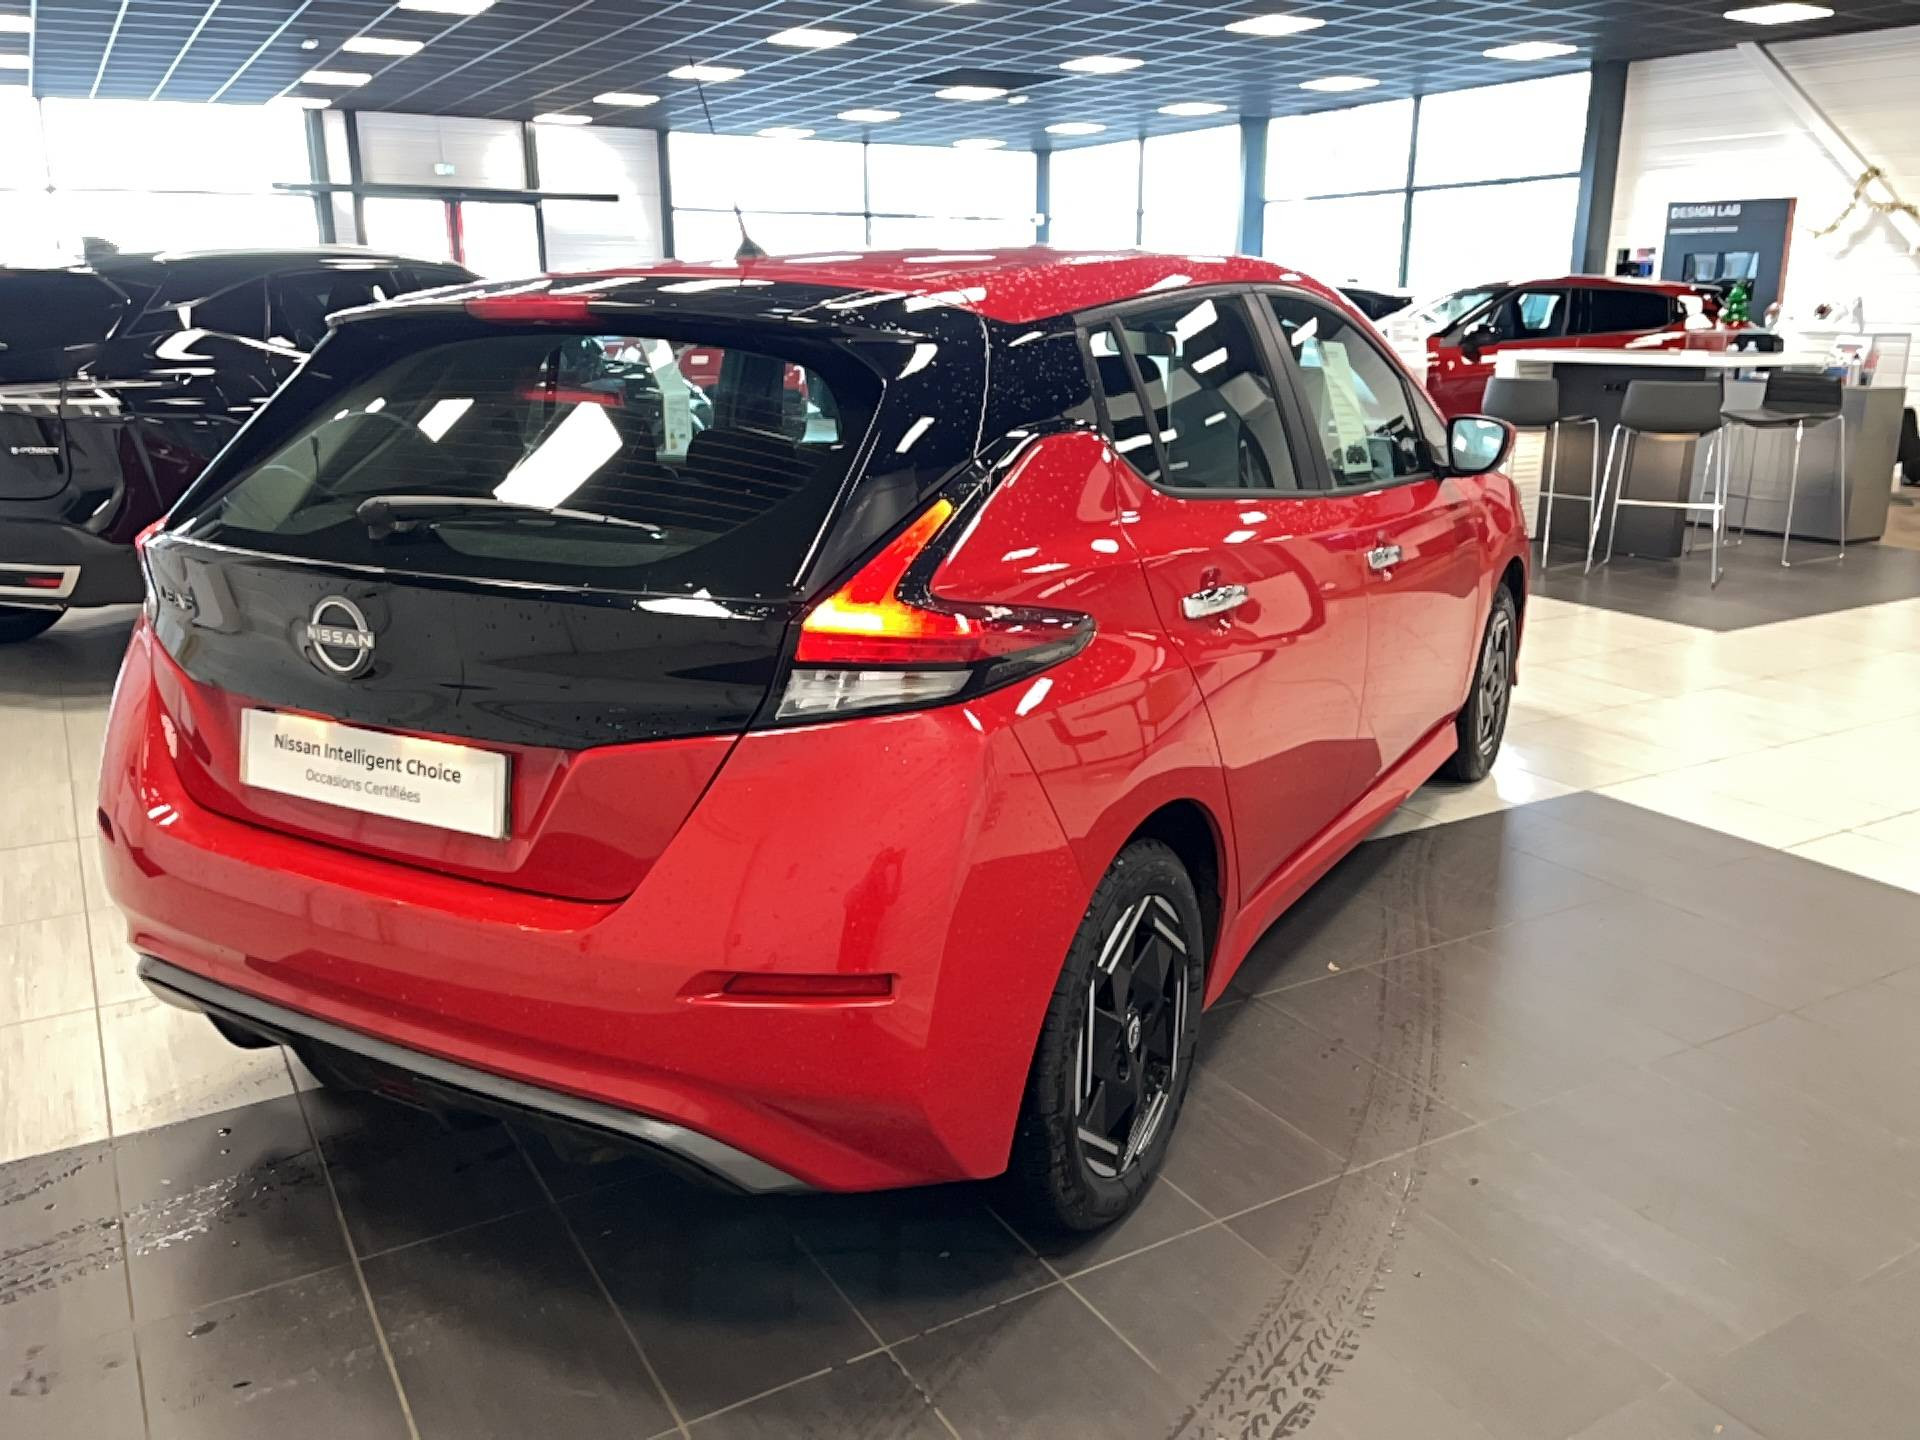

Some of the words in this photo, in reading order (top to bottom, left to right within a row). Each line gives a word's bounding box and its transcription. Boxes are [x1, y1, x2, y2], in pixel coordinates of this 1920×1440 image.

[1671, 205, 1715, 219] DESIGN
[1717, 203, 1741, 217] LAB
[307, 625, 374, 648] NISSAN
[274, 733, 321, 757] Nissan
[324, 743, 402, 772] Intelligent
[406, 758, 462, 784] Choice
[305, 768, 362, 792] Occasions
[364, 781, 421, 804] Certifiées
